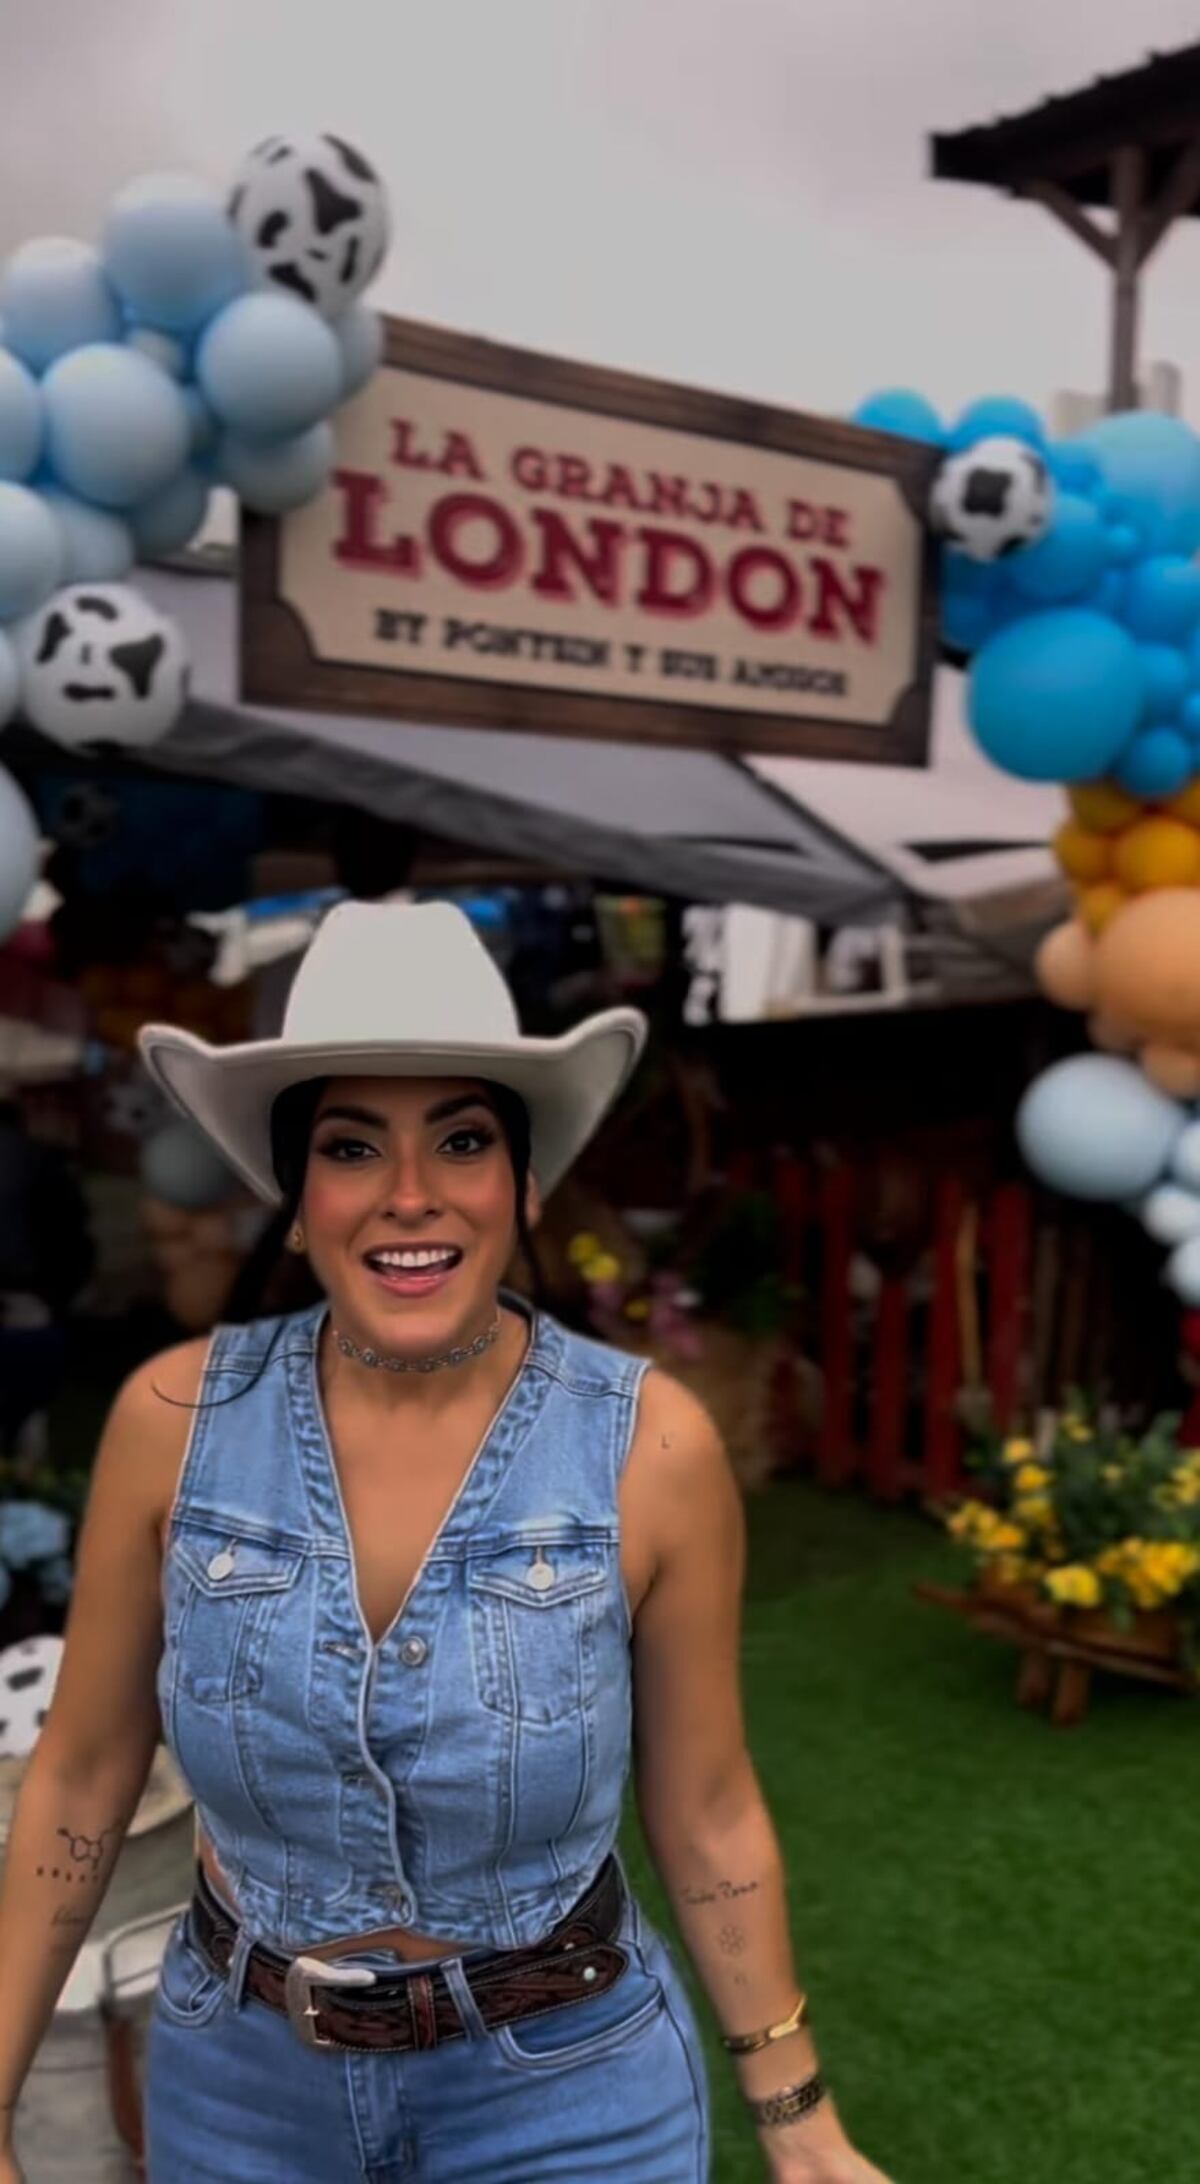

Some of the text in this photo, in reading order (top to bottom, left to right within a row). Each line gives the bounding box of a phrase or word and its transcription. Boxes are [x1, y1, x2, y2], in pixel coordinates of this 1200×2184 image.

[391, 417, 850, 549] LA GRANJA DE
[331, 468, 885, 647] LONDON
[375, 607, 427, 645] BY
[624, 644, 645, 675] Y
